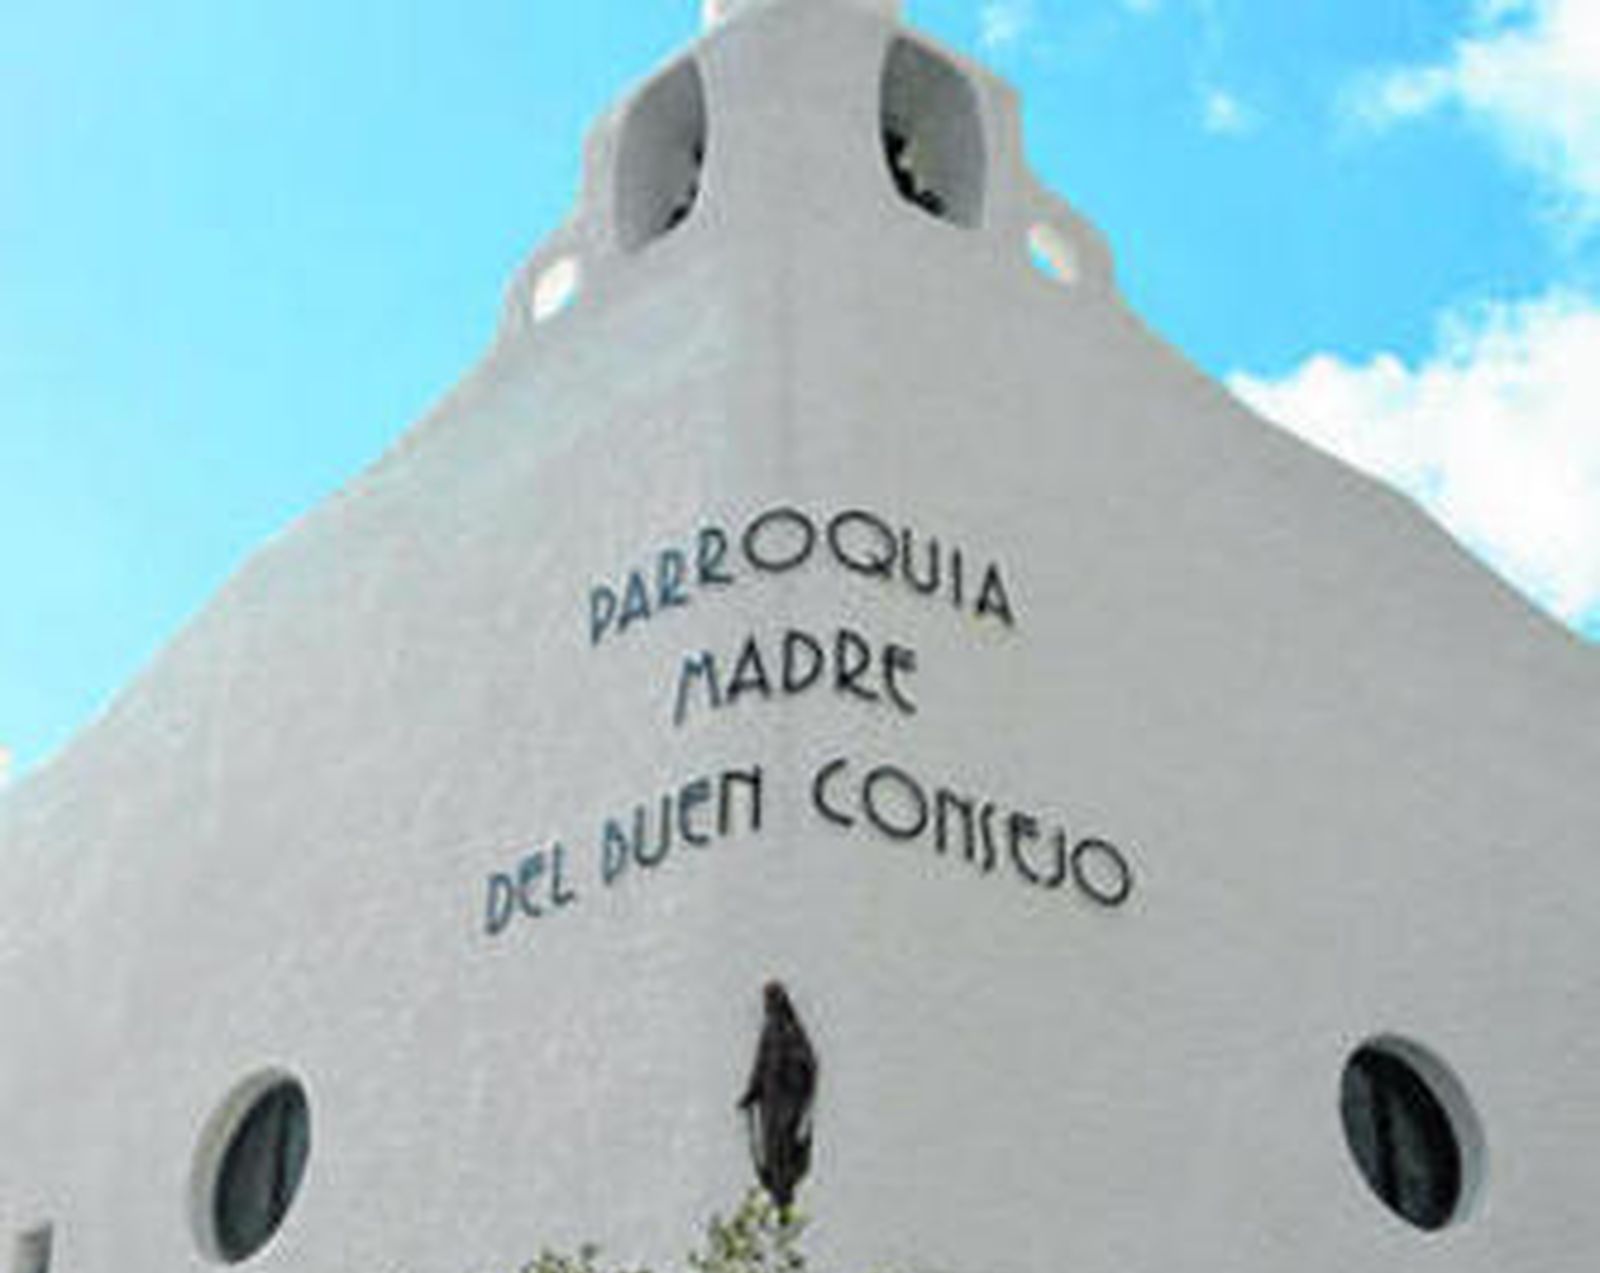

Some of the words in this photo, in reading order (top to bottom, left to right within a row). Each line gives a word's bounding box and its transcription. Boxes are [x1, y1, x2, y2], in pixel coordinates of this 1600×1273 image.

[588, 507, 1017, 645] PARROQUIA
[672, 628, 917, 728] MADRE
[484, 843, 576, 936] DEL
[812, 758, 1132, 908] CONSEJO
